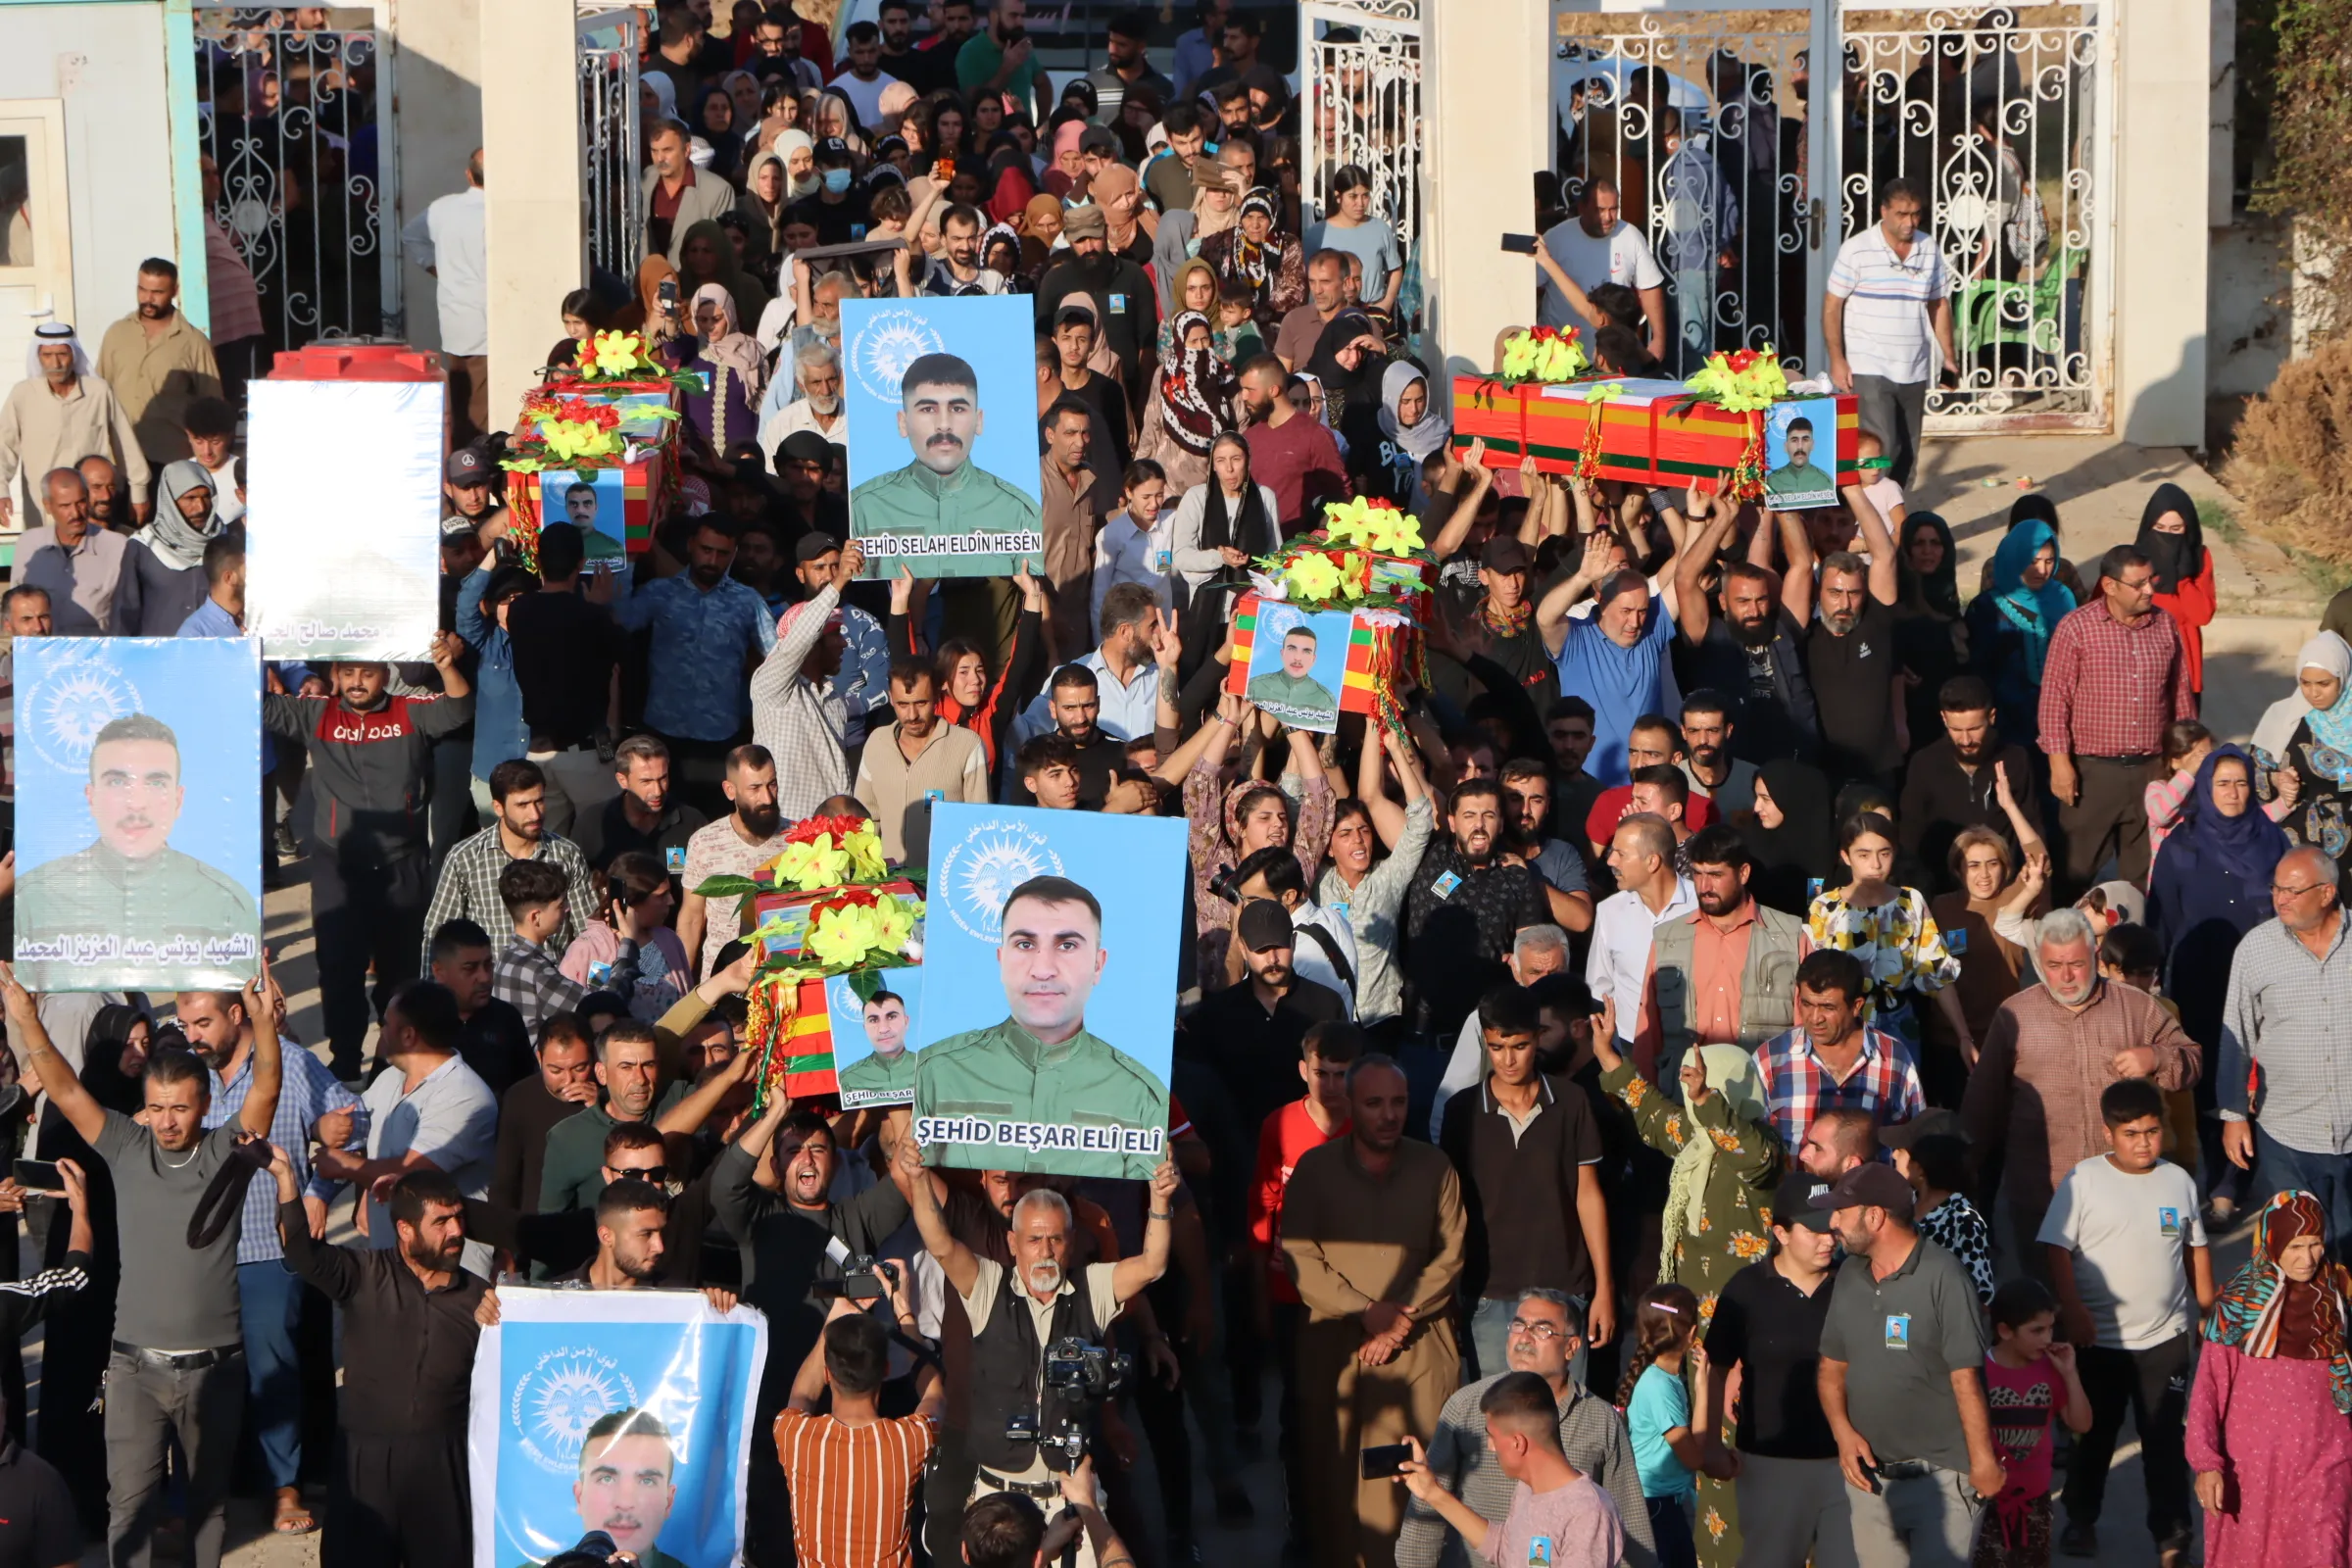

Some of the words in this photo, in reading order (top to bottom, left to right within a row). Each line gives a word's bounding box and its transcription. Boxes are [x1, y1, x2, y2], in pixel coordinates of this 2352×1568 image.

[902, 537, 946, 554] SELAH
[951, 532, 991, 553] ELDÎN
[995, 531, 1041, 552] HESÊN
[299, 622, 336, 644] صالح
[965, 819, 1000, 844] الداخلي
[1001, 819, 1028, 833] الأمن
[1027, 832, 1048, 845] قوى
[18, 938, 71, 958] المحمد
[76, 935, 119, 963] العزيز
[125, 940, 154, 963] عبد
[159, 936, 200, 962] يونس
[206, 934, 254, 962] الشهيد
[917, 1118, 991, 1144] ŞEHÎD
[999, 1123, 1076, 1151] BEŞAR
[1083, 1126, 1118, 1149] ELÎ
[1125, 1129, 1160, 1152] ELÎ
[570, 1345, 598, 1359] الأمن
[597, 1355, 618, 1370] قوى
